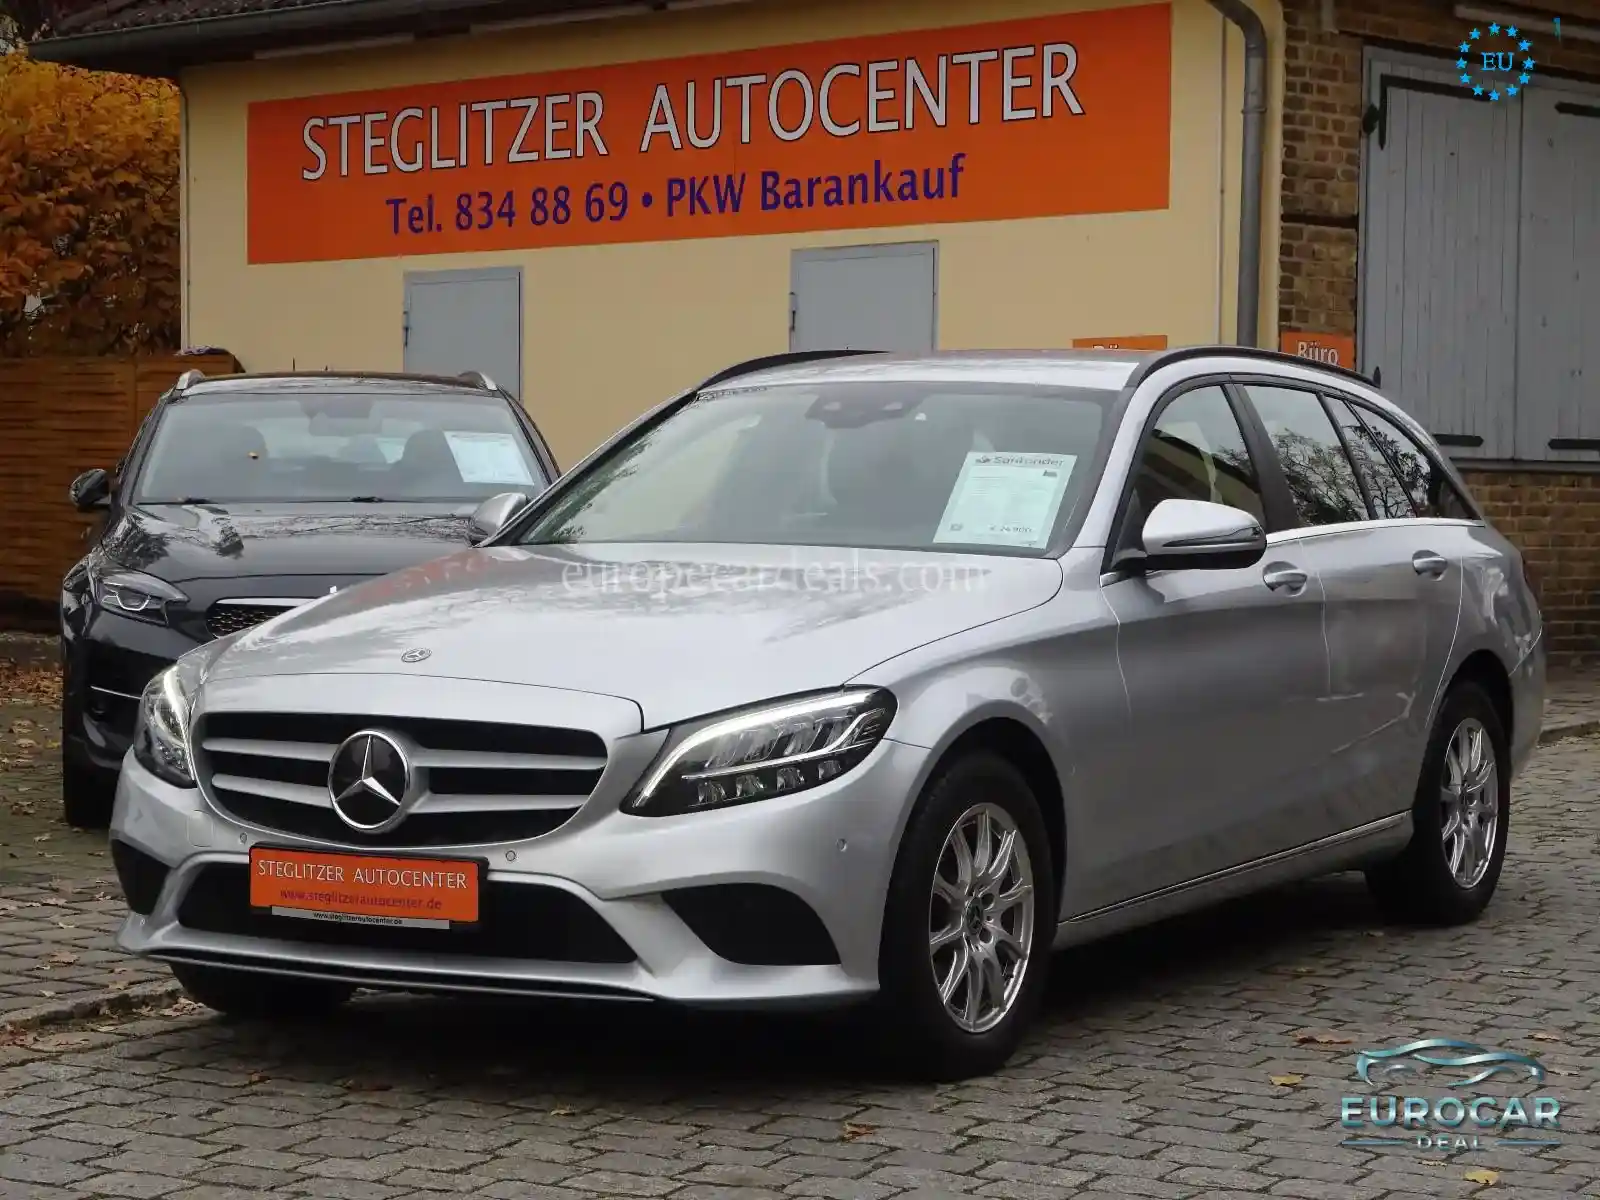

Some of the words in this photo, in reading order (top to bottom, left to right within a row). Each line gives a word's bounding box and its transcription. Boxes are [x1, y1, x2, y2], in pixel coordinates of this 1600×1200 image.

[301, 90, 610, 182] STEGLITZER
[638, 42, 1086, 154] AUTOCENTER
[386, 195, 442, 235] Tel.
[455, 190, 516, 231] 834
[530, 185, 571, 226] 88
[585, 181, 629, 222] 69
[666, 172, 747, 217] PKW
[760, 153, 966, 211] Barankauf
[1297, 340, 1339, 366] Büro
[256, 859, 345, 882] STEGLITZER
[353, 867, 468, 889] AUTOCENTER
[280, 888, 442, 910] www.steglitzerautocenter.de
